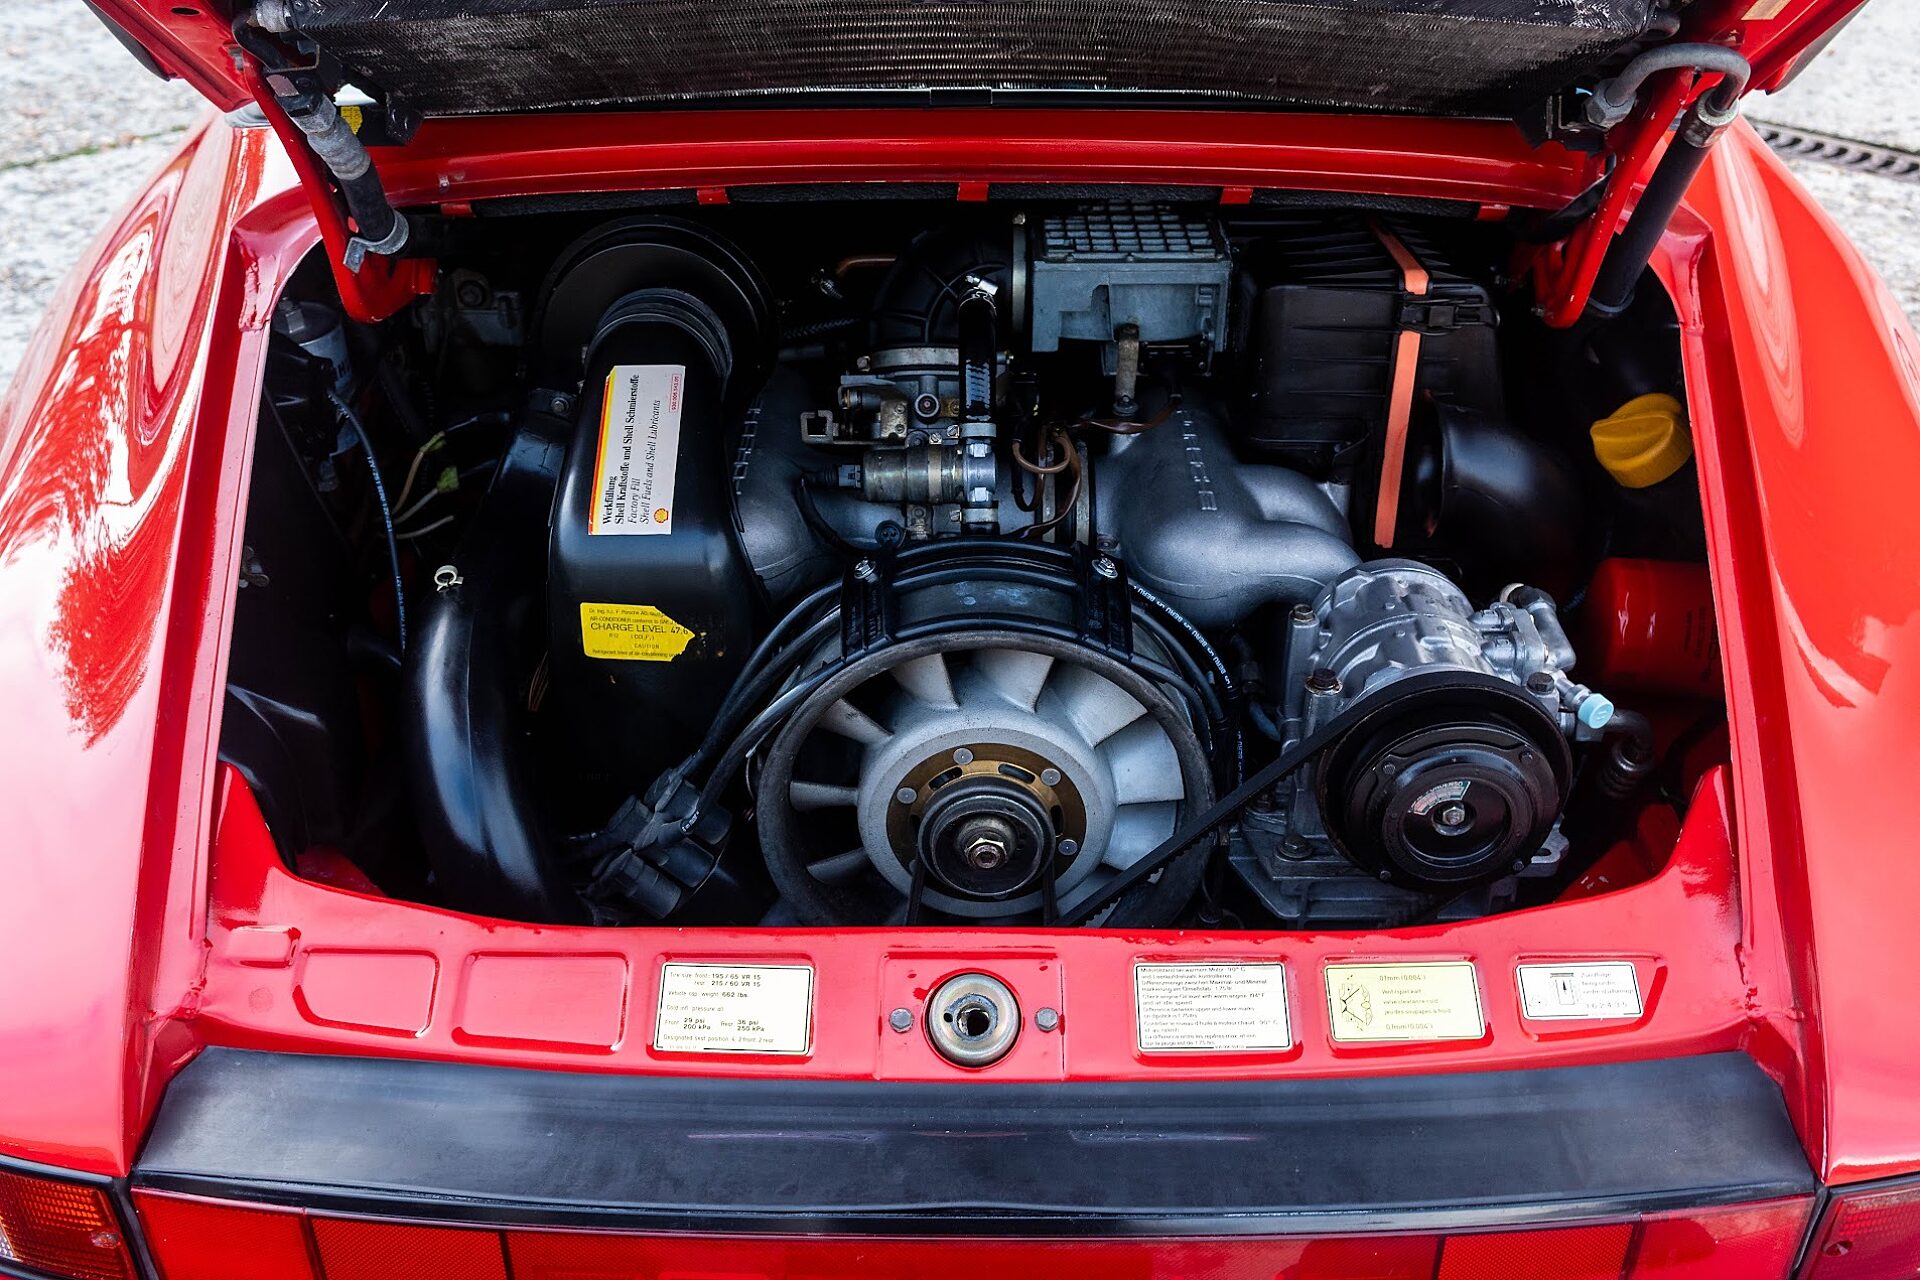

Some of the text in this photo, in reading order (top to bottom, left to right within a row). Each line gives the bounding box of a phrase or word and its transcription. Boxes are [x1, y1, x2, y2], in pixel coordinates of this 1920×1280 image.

[615, 375, 639, 524] Shell Kraftstoffe und Shell Schmierstoffe
[640, 400, 660, 524] Shell Fuels and Shell Lubricants
[603, 476, 617, 524] Werkfüllung
[627, 478, 641, 524] Factory Fill
[1137, 588, 1156, 602] BERU
[1165, 607, 1183, 622] BERU
[591, 622, 634, 632] CHARGE
[636, 624, 666, 633] LEVEL
[1192, 630, 1208, 647] BERU
[1213, 656, 1226, 674] BERU
